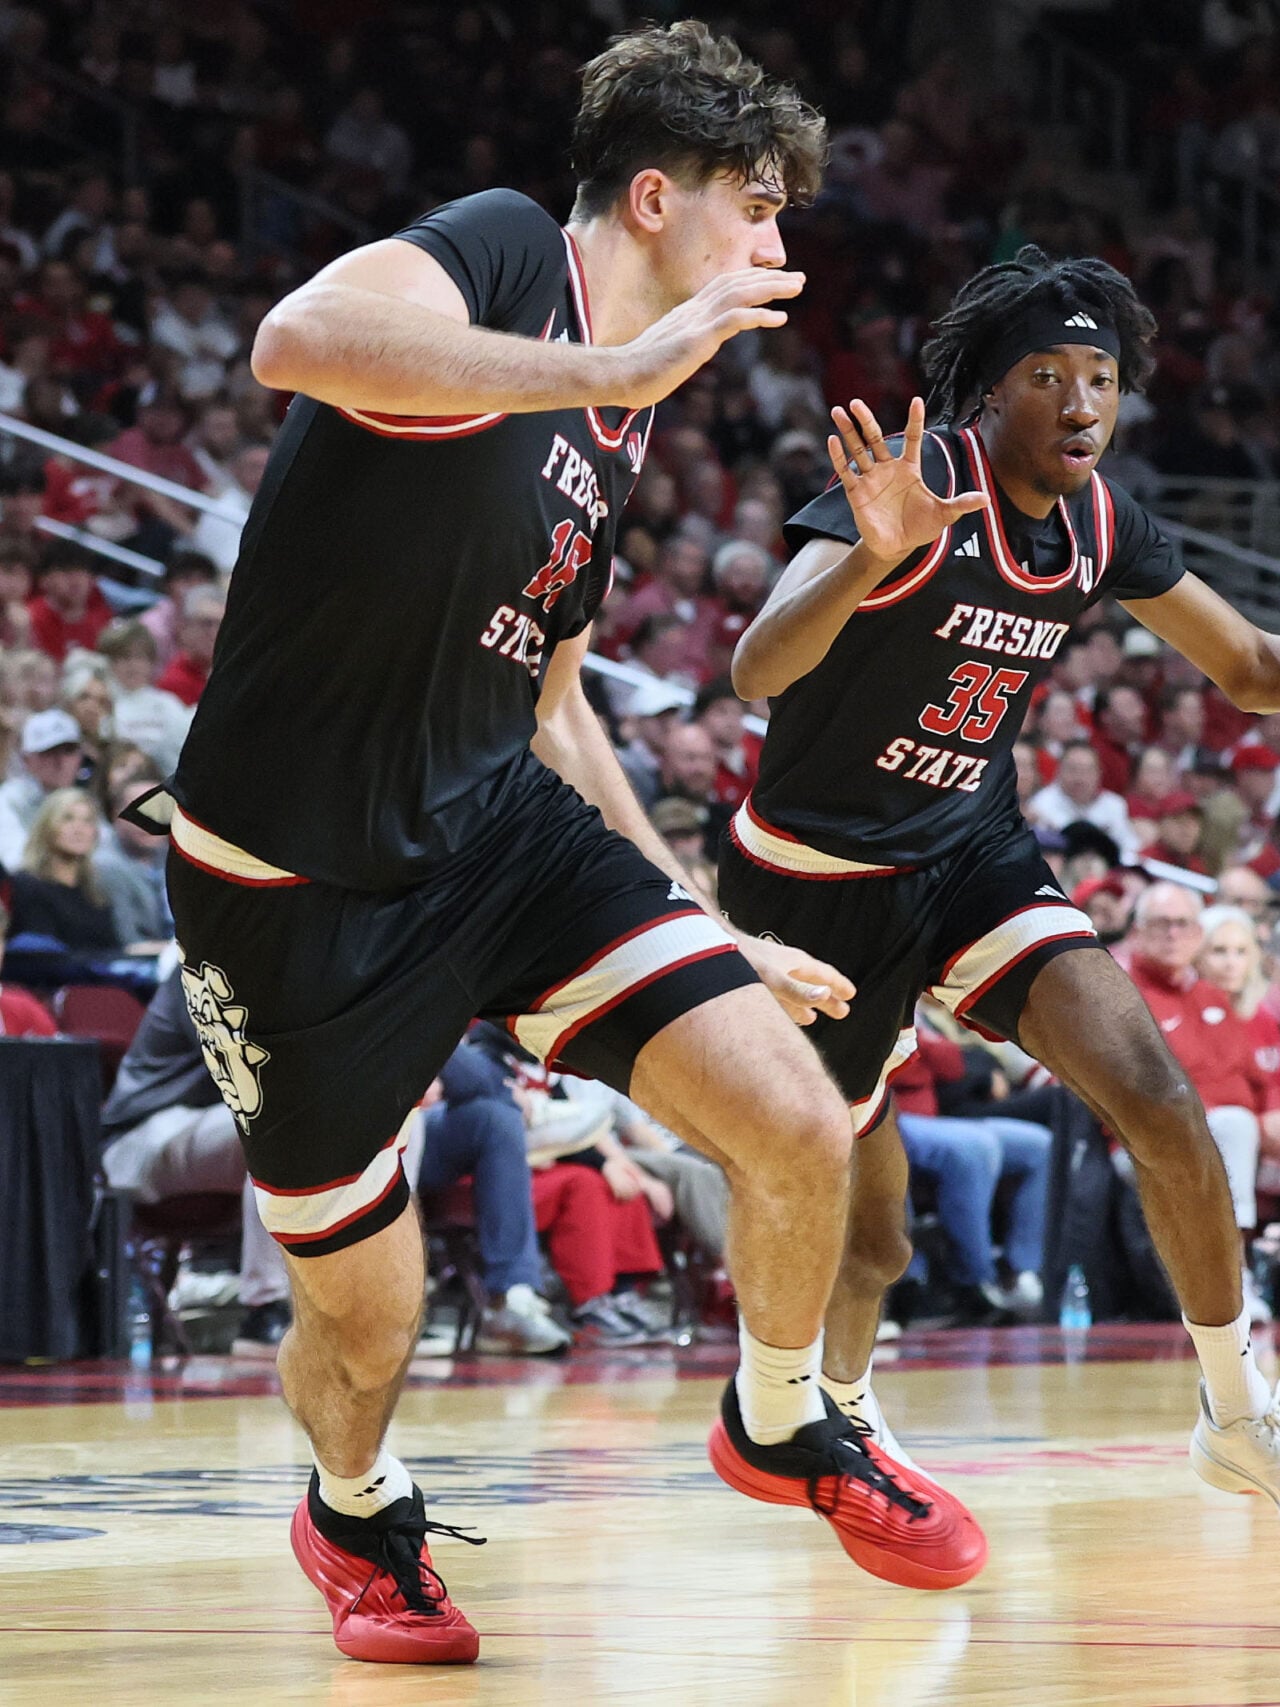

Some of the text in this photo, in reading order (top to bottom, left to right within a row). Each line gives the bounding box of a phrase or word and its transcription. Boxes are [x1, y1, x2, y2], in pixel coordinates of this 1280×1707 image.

[933, 603, 1070, 659] FRESNO
[918, 660, 1029, 743] 35
[875, 737, 989, 792] STATE
